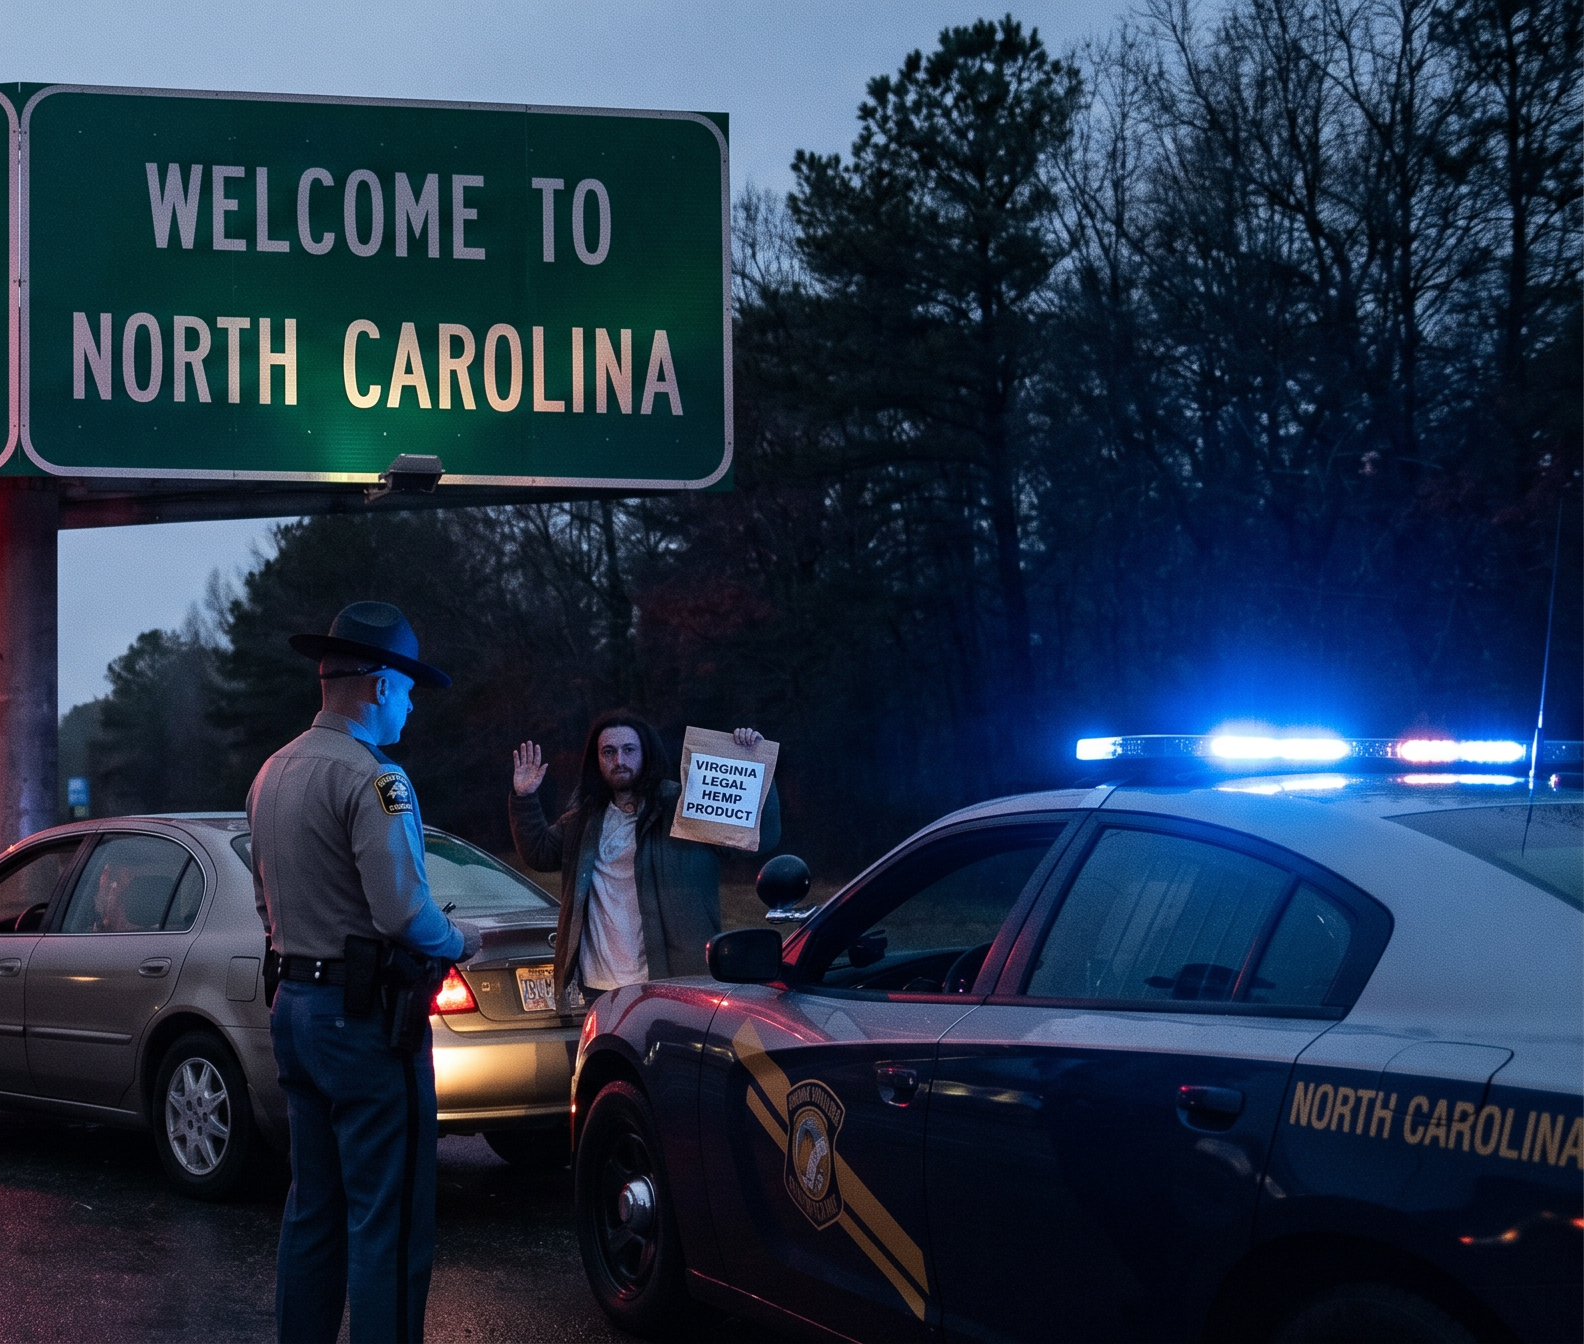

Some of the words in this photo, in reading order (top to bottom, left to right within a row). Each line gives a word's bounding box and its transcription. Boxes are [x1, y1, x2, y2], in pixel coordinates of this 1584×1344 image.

[145, 162, 486, 260] WELCOME
[532, 177, 612, 266] TO
[73, 312, 298, 405] NORTH
[343, 319, 684, 416] CAROLINA
[696, 760, 757, 778] VIRGINIA
[702, 775, 747, 790] LEGAL
[702, 790, 742, 804] HEMP
[686, 802, 752, 821] PRODUCT
[1289, 1081, 1398, 1139] NORTH
[1403, 1095, 1584, 1170] CAROLINA
